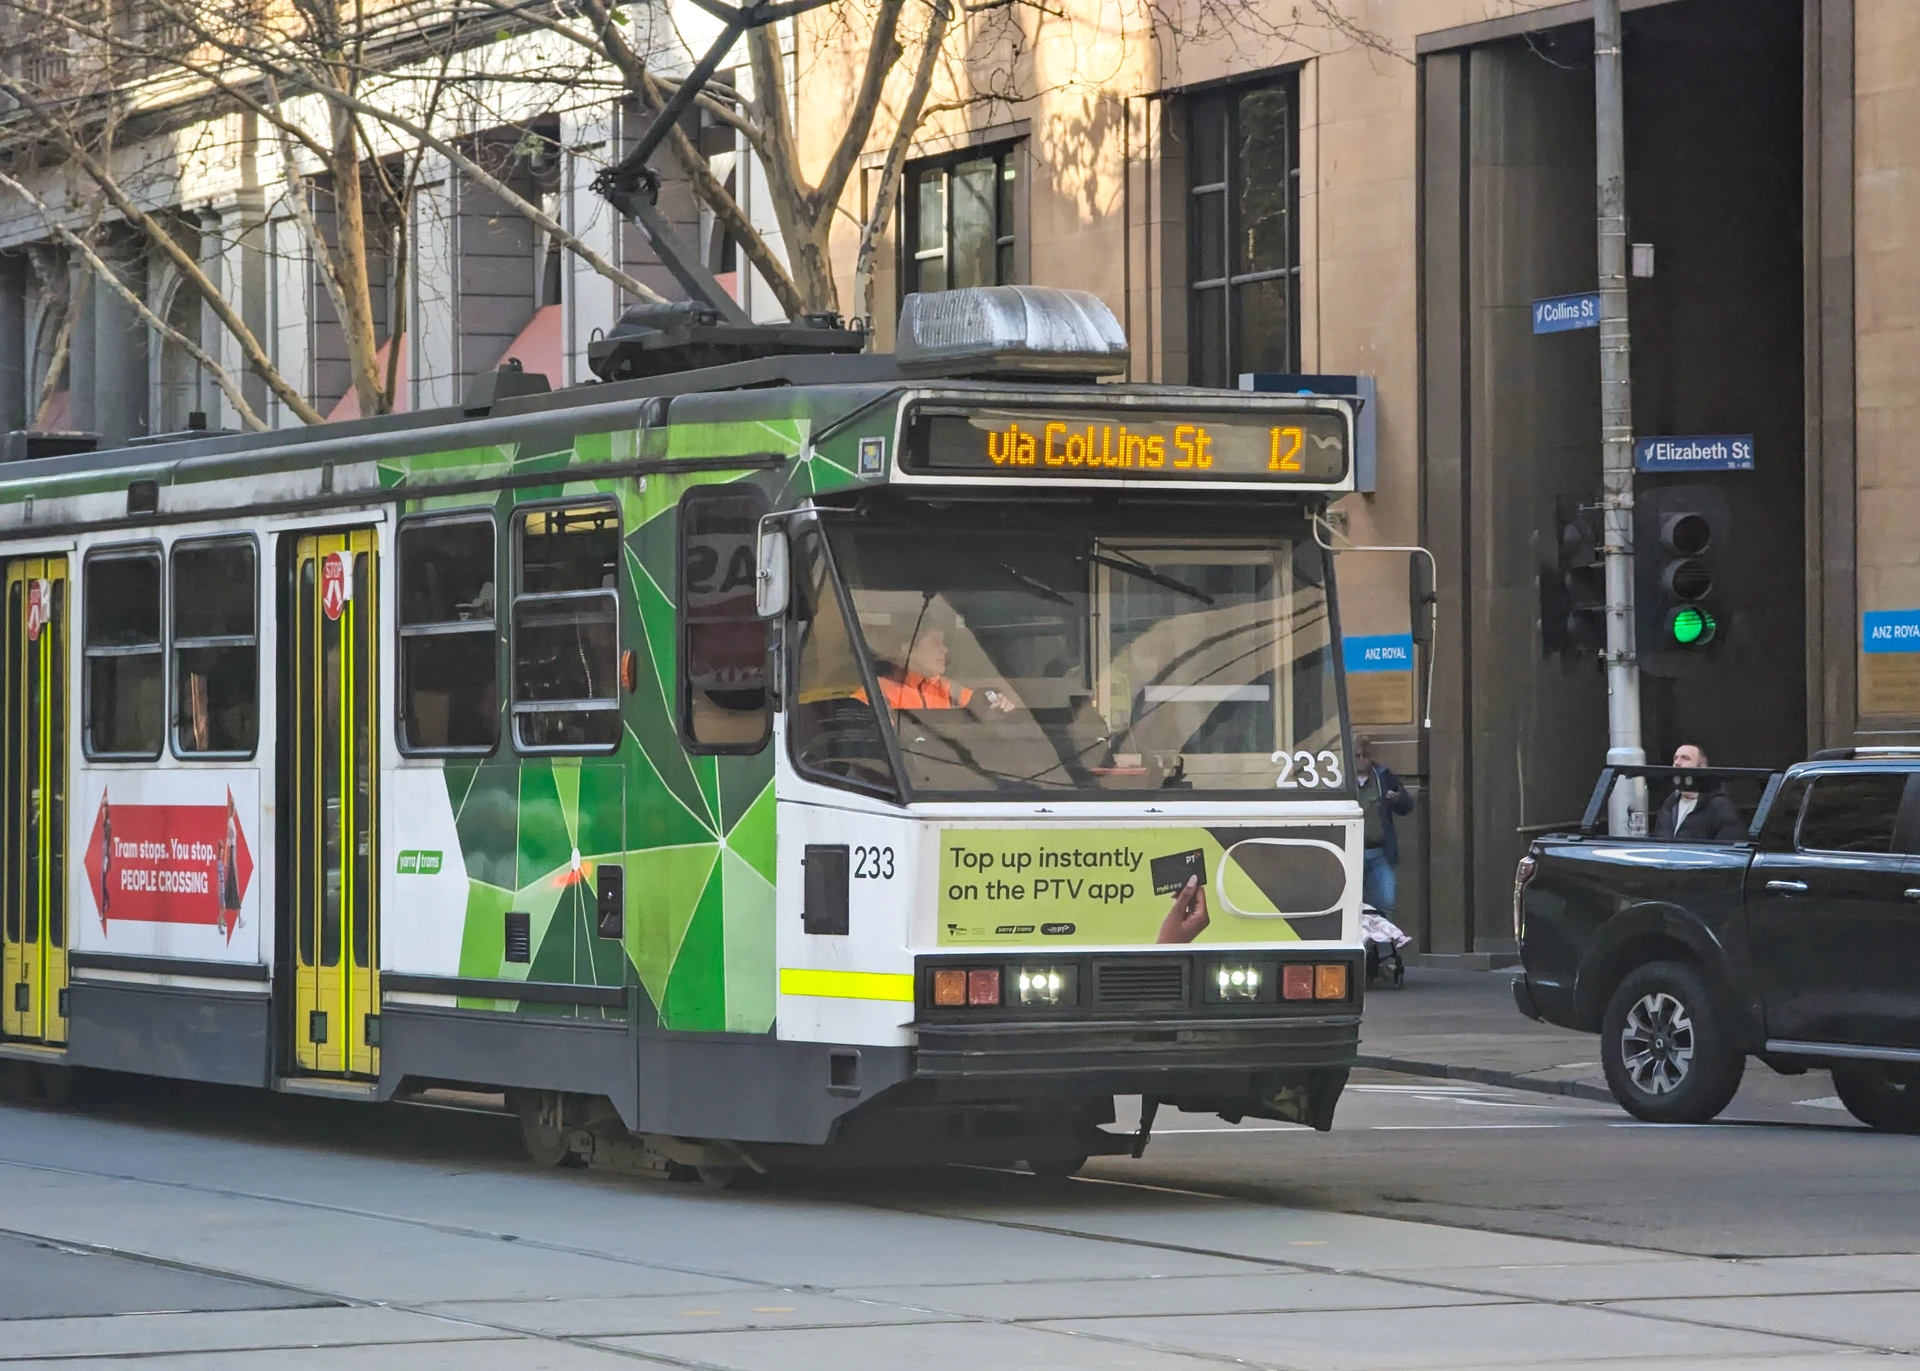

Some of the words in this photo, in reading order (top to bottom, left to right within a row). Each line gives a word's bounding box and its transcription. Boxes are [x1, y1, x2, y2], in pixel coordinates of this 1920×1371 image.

[1544, 302, 1579, 321] Collins
[1581, 299, 1594, 317] St
[987, 423, 1036, 466] via
[1043, 421, 1165, 468] Collins
[1173, 424, 1213, 469] St
[1267, 427, 1303, 471] 12
[1656, 442, 1728, 460] Elizabeth
[1731, 441, 1751, 459] St
[325, 562, 341, 579] STOP
[1871, 625, 1892, 639] ANZ
[1364, 648, 1381, 660] ANZ
[1382, 647, 1407, 659] ROYAL
[1271, 750, 1343, 788] 233
[113, 837, 138, 858] Tram
[139, 840, 169, 864] stops.
[170, 838, 190, 860] You
[191, 841, 216, 866] stop.
[420, 854, 440, 868] trams
[854, 845, 895, 880] 233
[949, 847, 994, 874] Top
[1001, 852, 1032, 874] up
[1039, 846, 1144, 873] instantly
[121, 869, 157, 892] PEOPLE
[158, 870, 208, 894] CROSSING
[948, 884, 978, 900] on
[985, 879, 1026, 900] the
[1034, 878, 1084, 900] PTV
[1088, 883, 1135, 904] app
